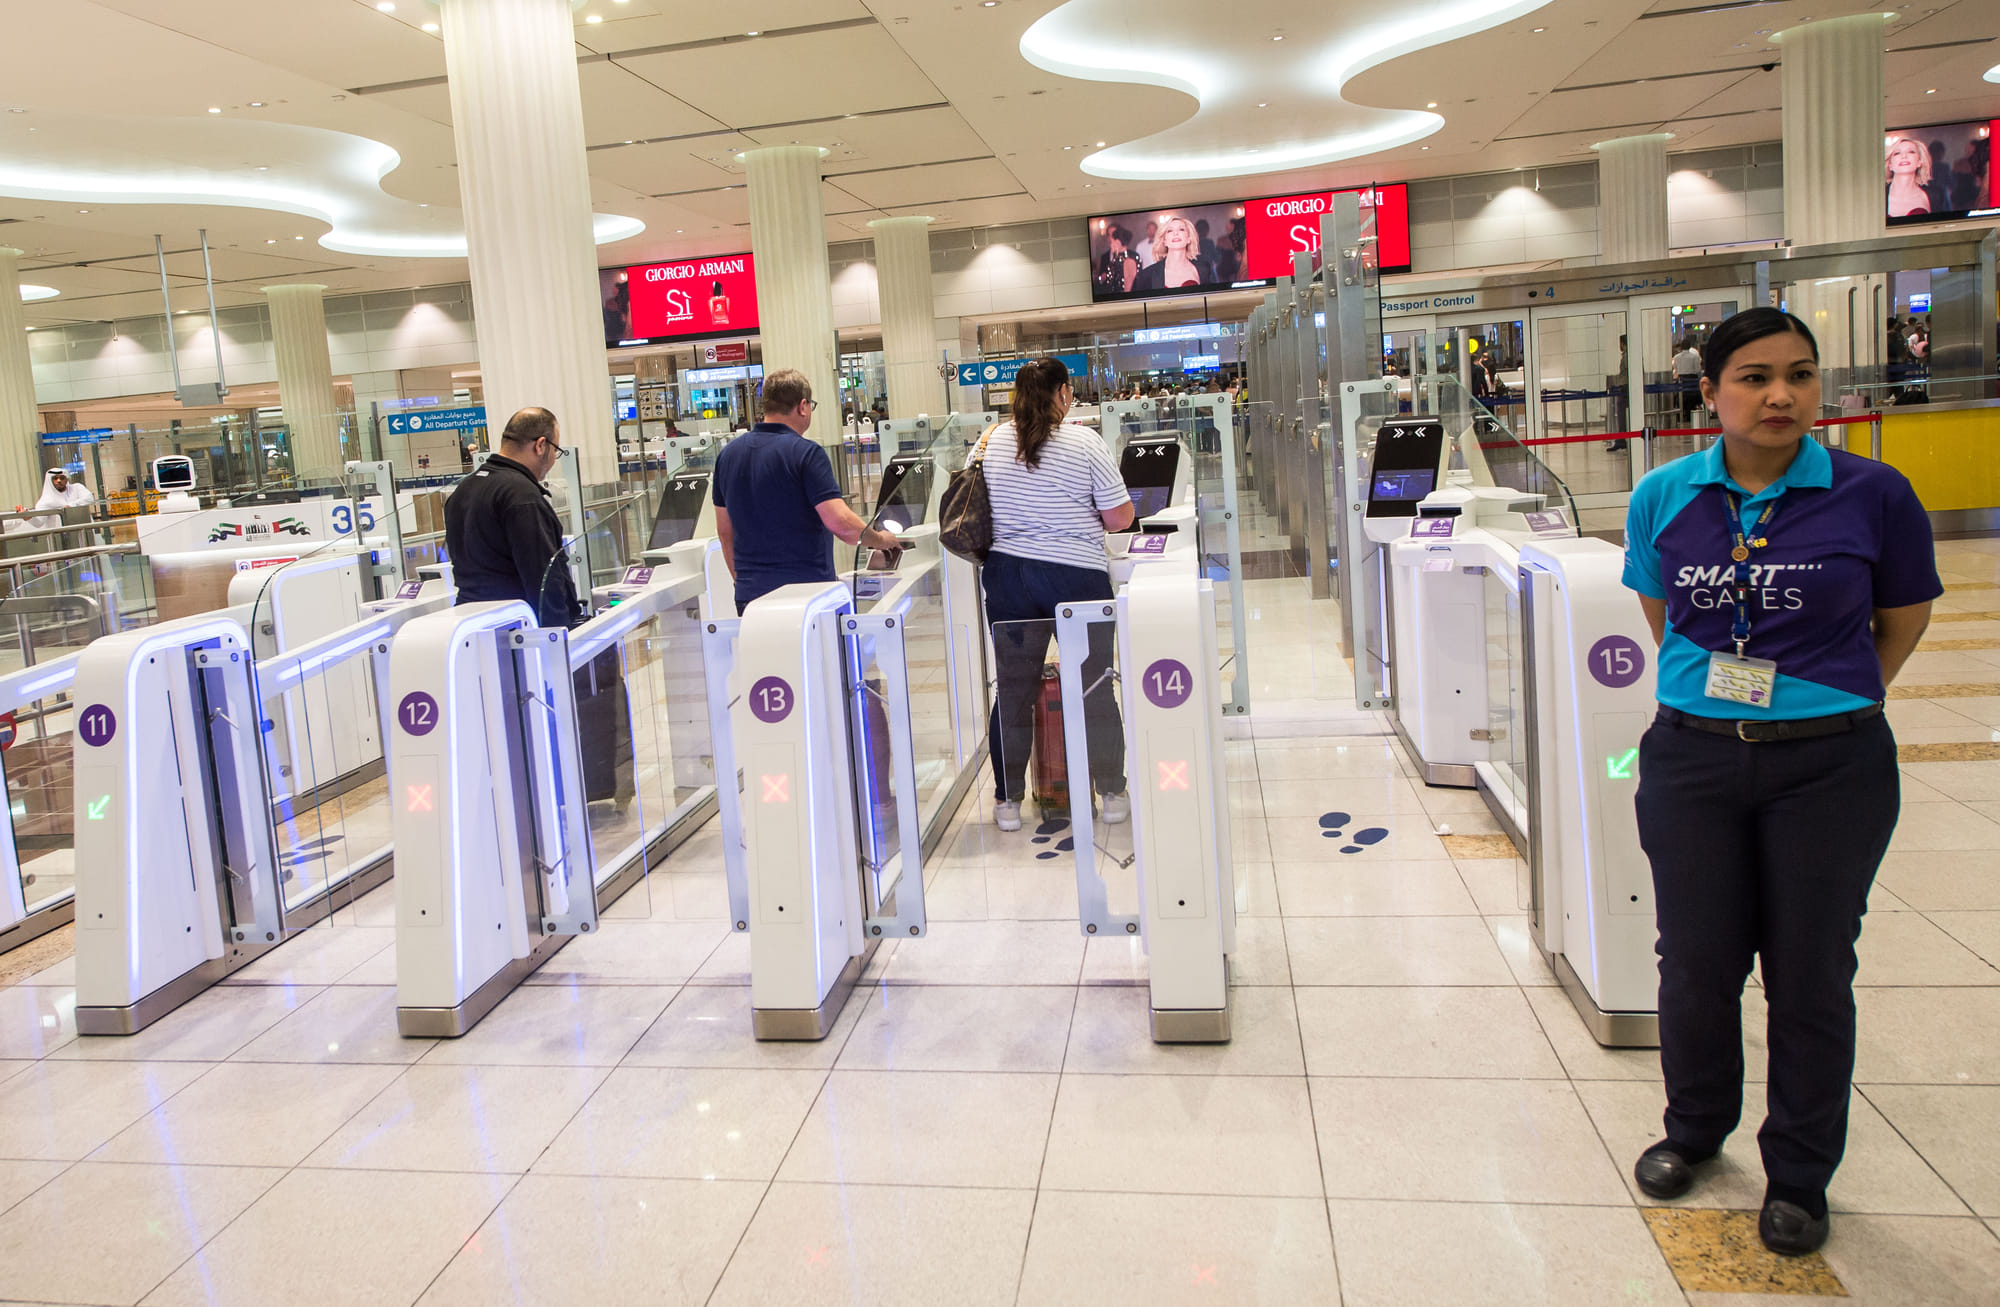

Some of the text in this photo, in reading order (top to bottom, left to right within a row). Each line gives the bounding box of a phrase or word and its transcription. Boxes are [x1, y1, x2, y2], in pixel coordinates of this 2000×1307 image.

[1266, 198, 1325, 217] GIORGIO
[645, 259, 744, 282] GIORGIO ARMANI
[1545, 286, 1555, 299] 4
[1599, 279, 1648, 293] الجوازات
[666, 288, 694, 317] Sì
[1380, 294, 1475, 312] Passport Control
[1001, 371, 1012, 379] All
[425, 421, 434, 429] All
[435, 419, 468, 429] Departure
[622, 445, 630, 453] 01
[332, 503, 375, 534] 35
[1675, 564, 1786, 587] SMART
[1691, 587, 1803, 610] GAES
[1600, 647, 1634, 675] 15
[1152, 670, 1185, 697] 14
[759, 686, 786, 712] 13
[406, 701, 432, 725] 12
[87, 713, 107, 737] 11
